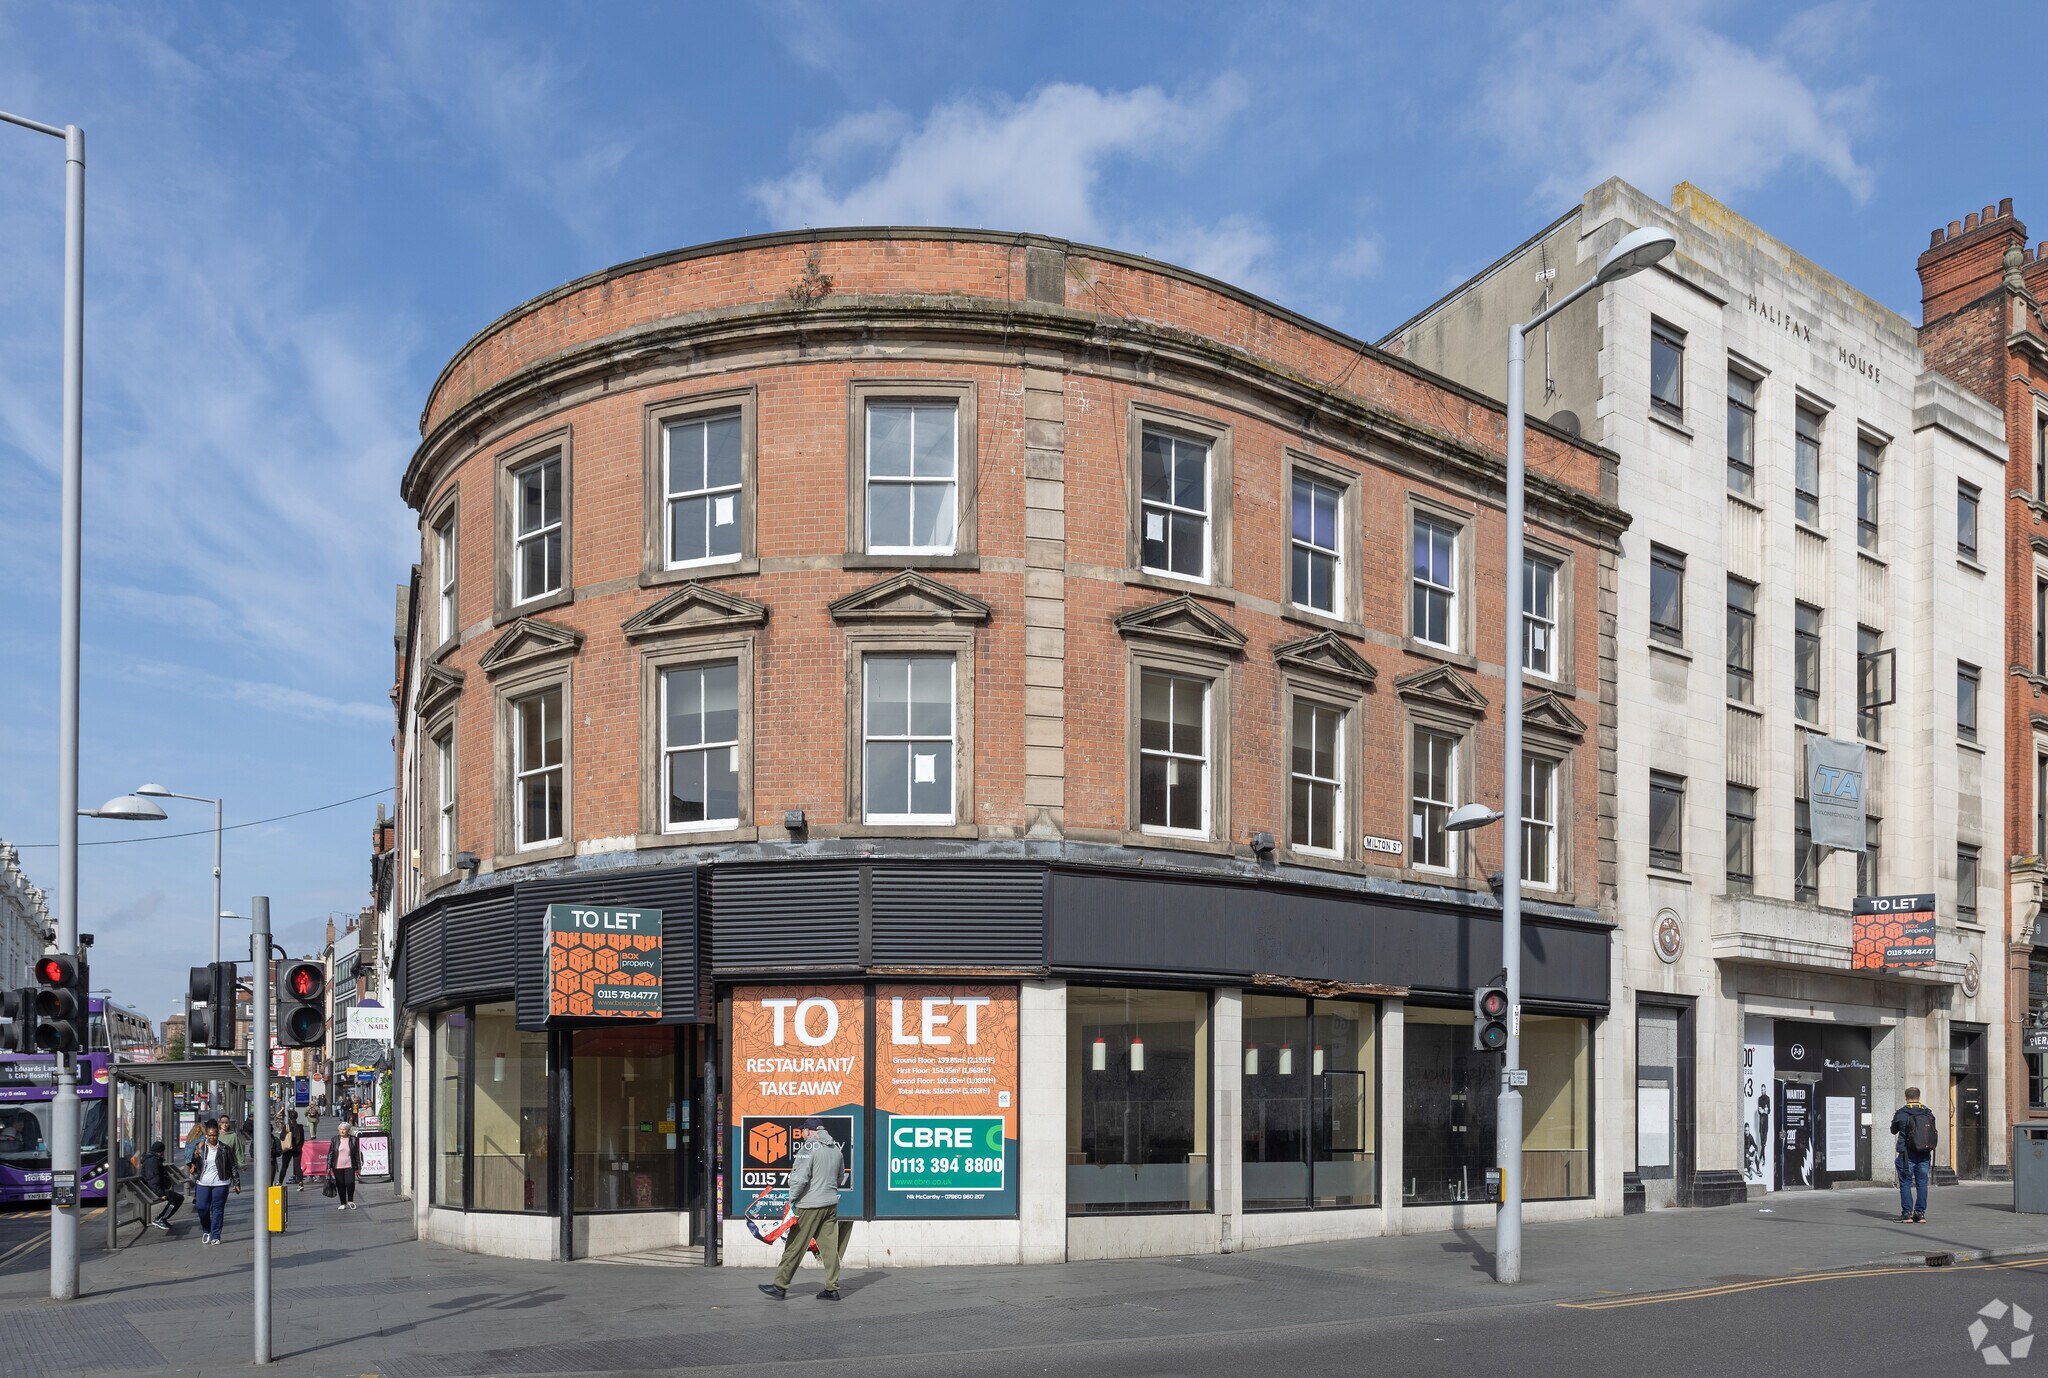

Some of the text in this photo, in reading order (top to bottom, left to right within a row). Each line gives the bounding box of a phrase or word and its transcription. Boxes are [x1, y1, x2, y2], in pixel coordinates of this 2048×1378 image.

[1749, 293, 1880, 384] HALIFAX HOUSE
[1818, 766, 1859, 799] TA
[1366, 837, 1391, 850] MILTON
[1871, 897, 1918, 911] TO LET
[571, 910, 641, 930] TO LET
[621, 952, 639, 960] BOX
[621, 959, 655, 969] property
[597, 989, 659, 1000] 0115 7844777
[761, 996, 839, 1047] TO
[891, 996, 990, 1045] LET
[746, 1056, 855, 1075] RESTAURANT/
[758, 1081, 843, 1096] TAKEAWAY
[898, 1087, 914, 1095] Total
[915, 1087, 932, 1095] Area:
[1786, 1089, 1805, 1099] WANTED
[893, 1127, 973, 1148] CBRE
[891, 1157, 1002, 1173] 0113 394 8800
[744, 1172, 776, 1185] 0115
